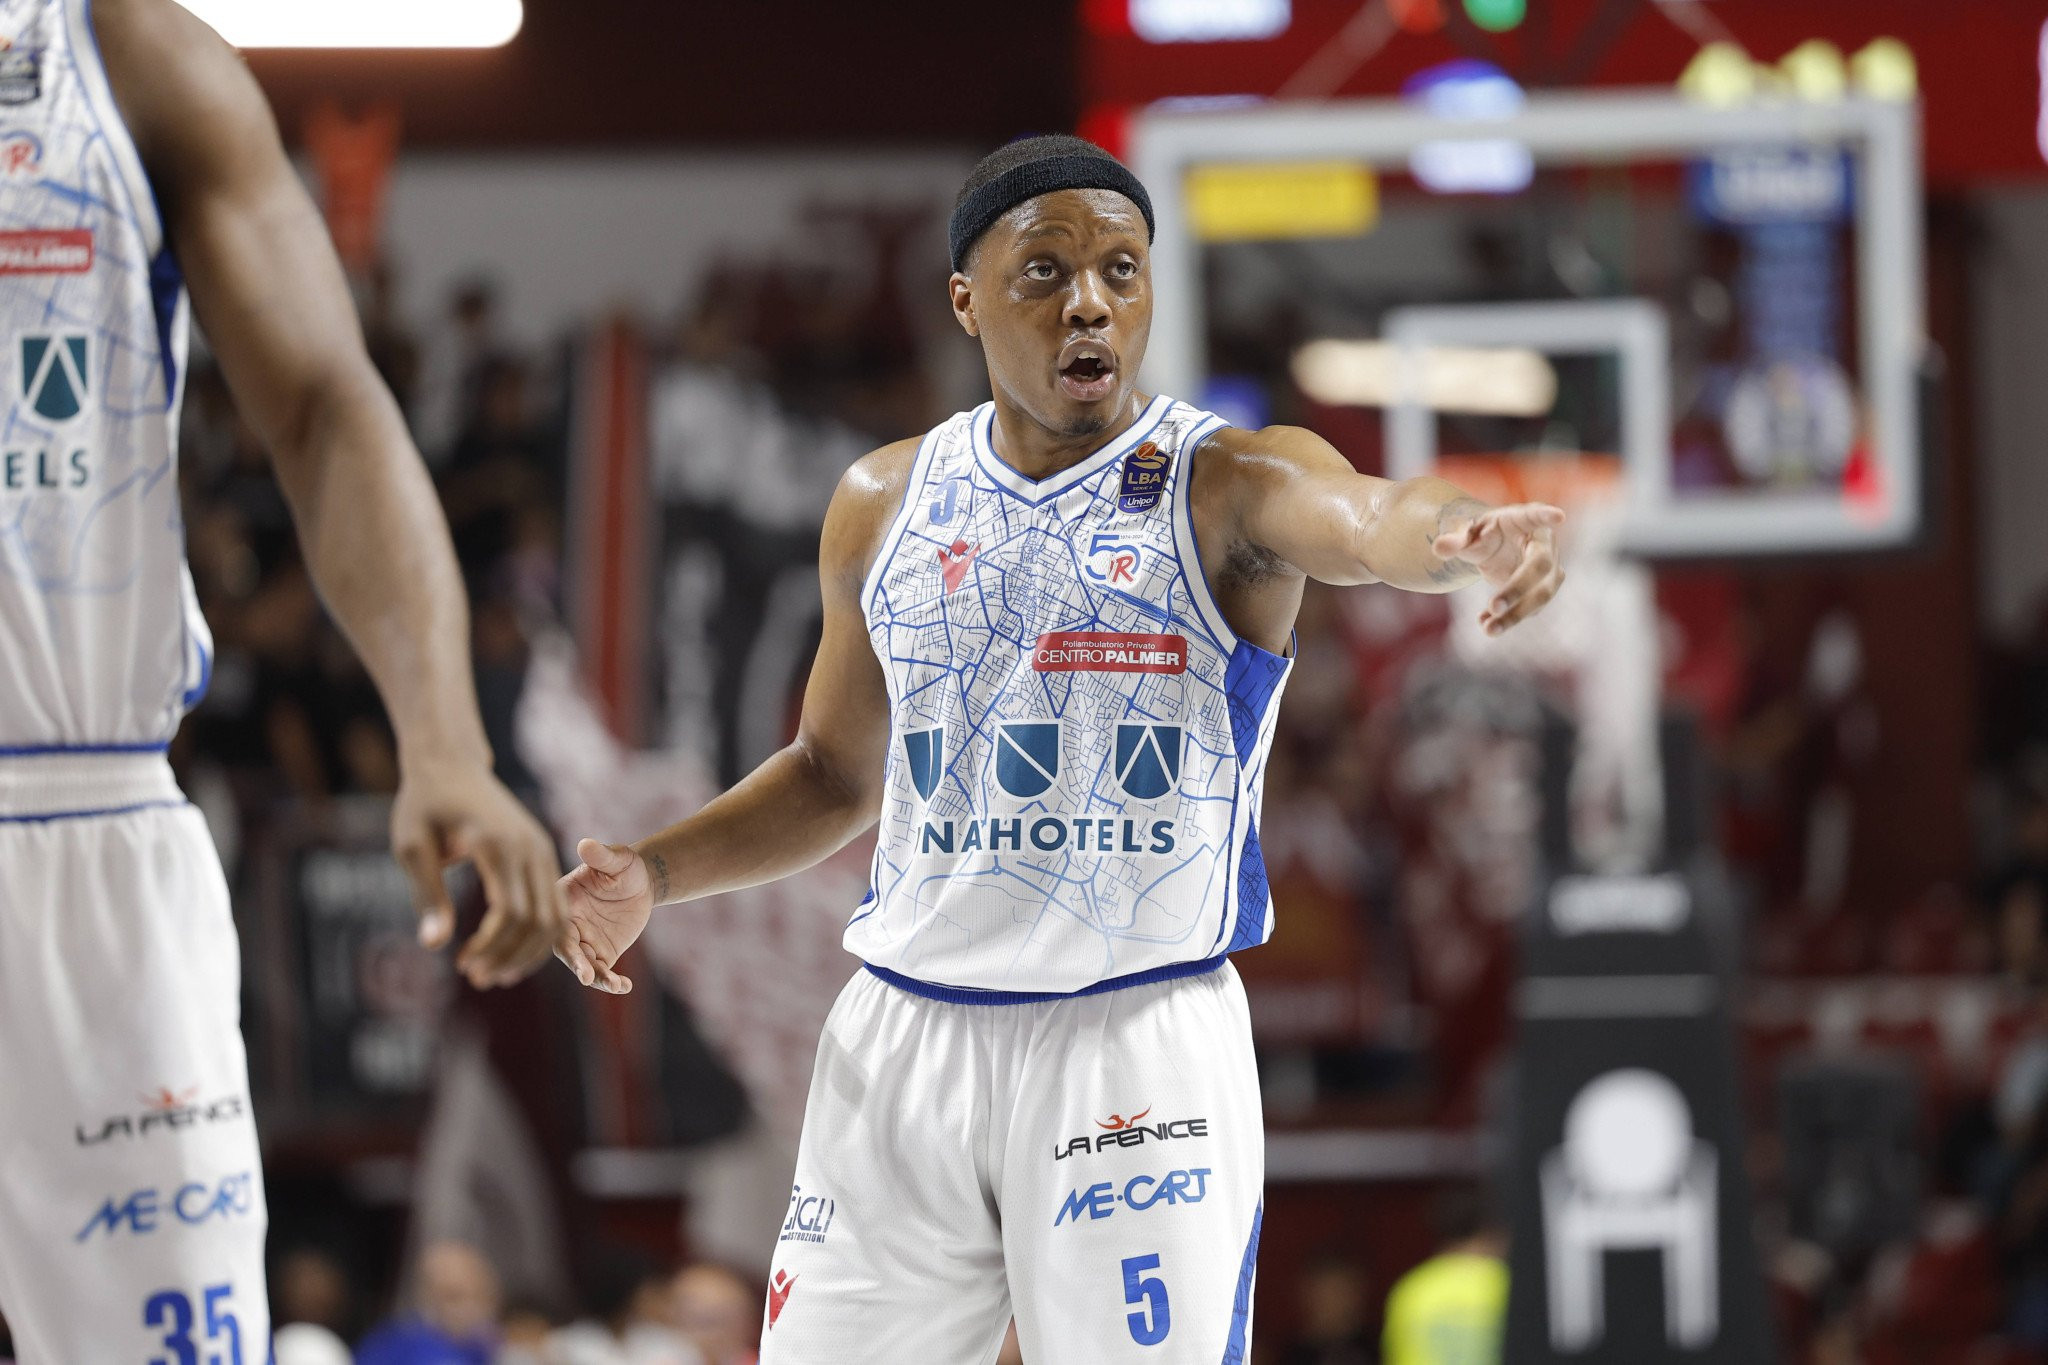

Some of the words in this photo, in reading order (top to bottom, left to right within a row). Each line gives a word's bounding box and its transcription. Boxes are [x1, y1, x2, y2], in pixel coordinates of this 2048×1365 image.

[1127, 472, 1161, 484] LBA
[1127, 495, 1155, 508] Unipol
[1062, 640, 1125, 649] Poliambulatorio
[1127, 641, 1156, 650] Privato
[1055, 1137, 1092, 1161] LA
[1096, 1118, 1209, 1153] FENICE
[1121, 1253, 1171, 1346] 5
[143, 1285, 244, 1365] 35
